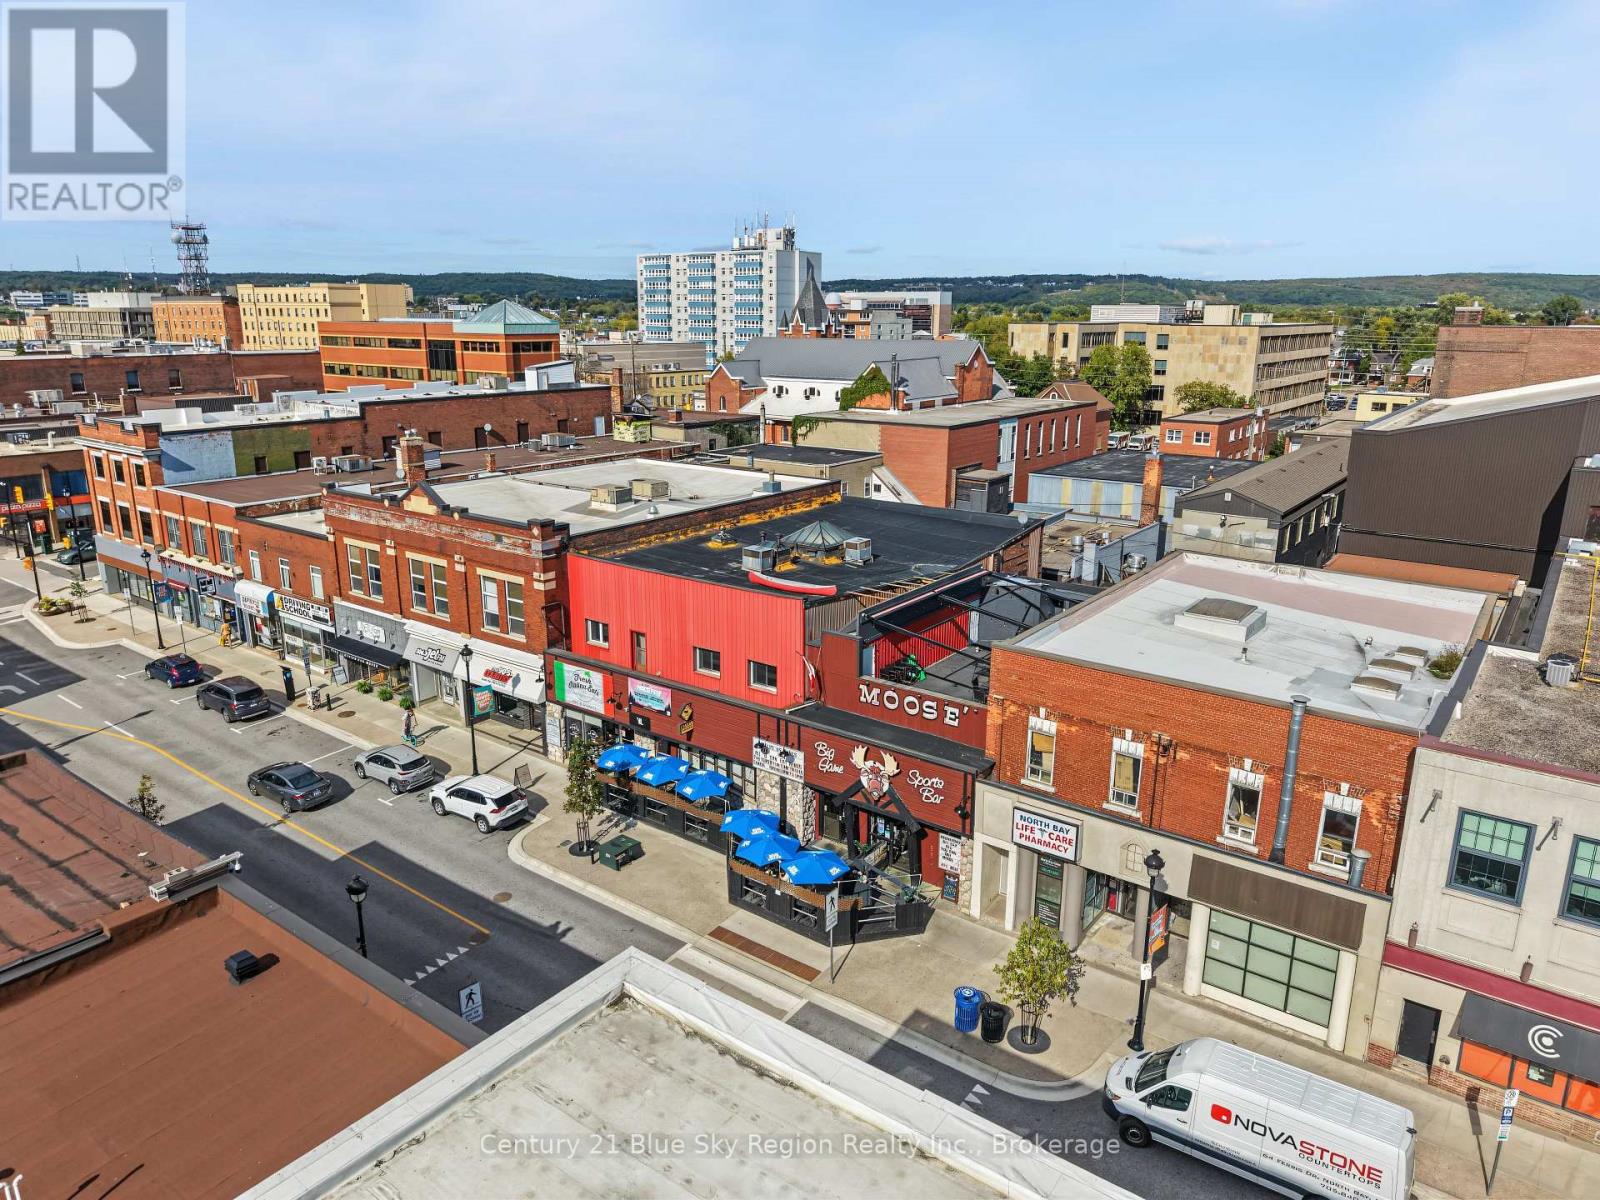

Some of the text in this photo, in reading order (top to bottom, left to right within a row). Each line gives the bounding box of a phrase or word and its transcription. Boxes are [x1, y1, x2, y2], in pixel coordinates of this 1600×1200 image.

[283, 596, 311, 611] DRIVING
[284, 604, 312, 619] SCHOOL
[815, 741, 835, 760] Big
[818, 758, 844, 774] Game
[907, 769, 944, 789] Sports
[920, 787, 945, 804] Bar
[1015, 822, 1074, 847] LIFE CARE
[1019, 814, 1070, 836] NORTH BAY
[1019, 832, 1069, 854] PHARMACY
[1234, 1114, 1384, 1183] NOVASTONE
[1298, 1152, 1381, 1190] COUNTERTOPS
[1322, 1177, 1350, 1192] NORTH
